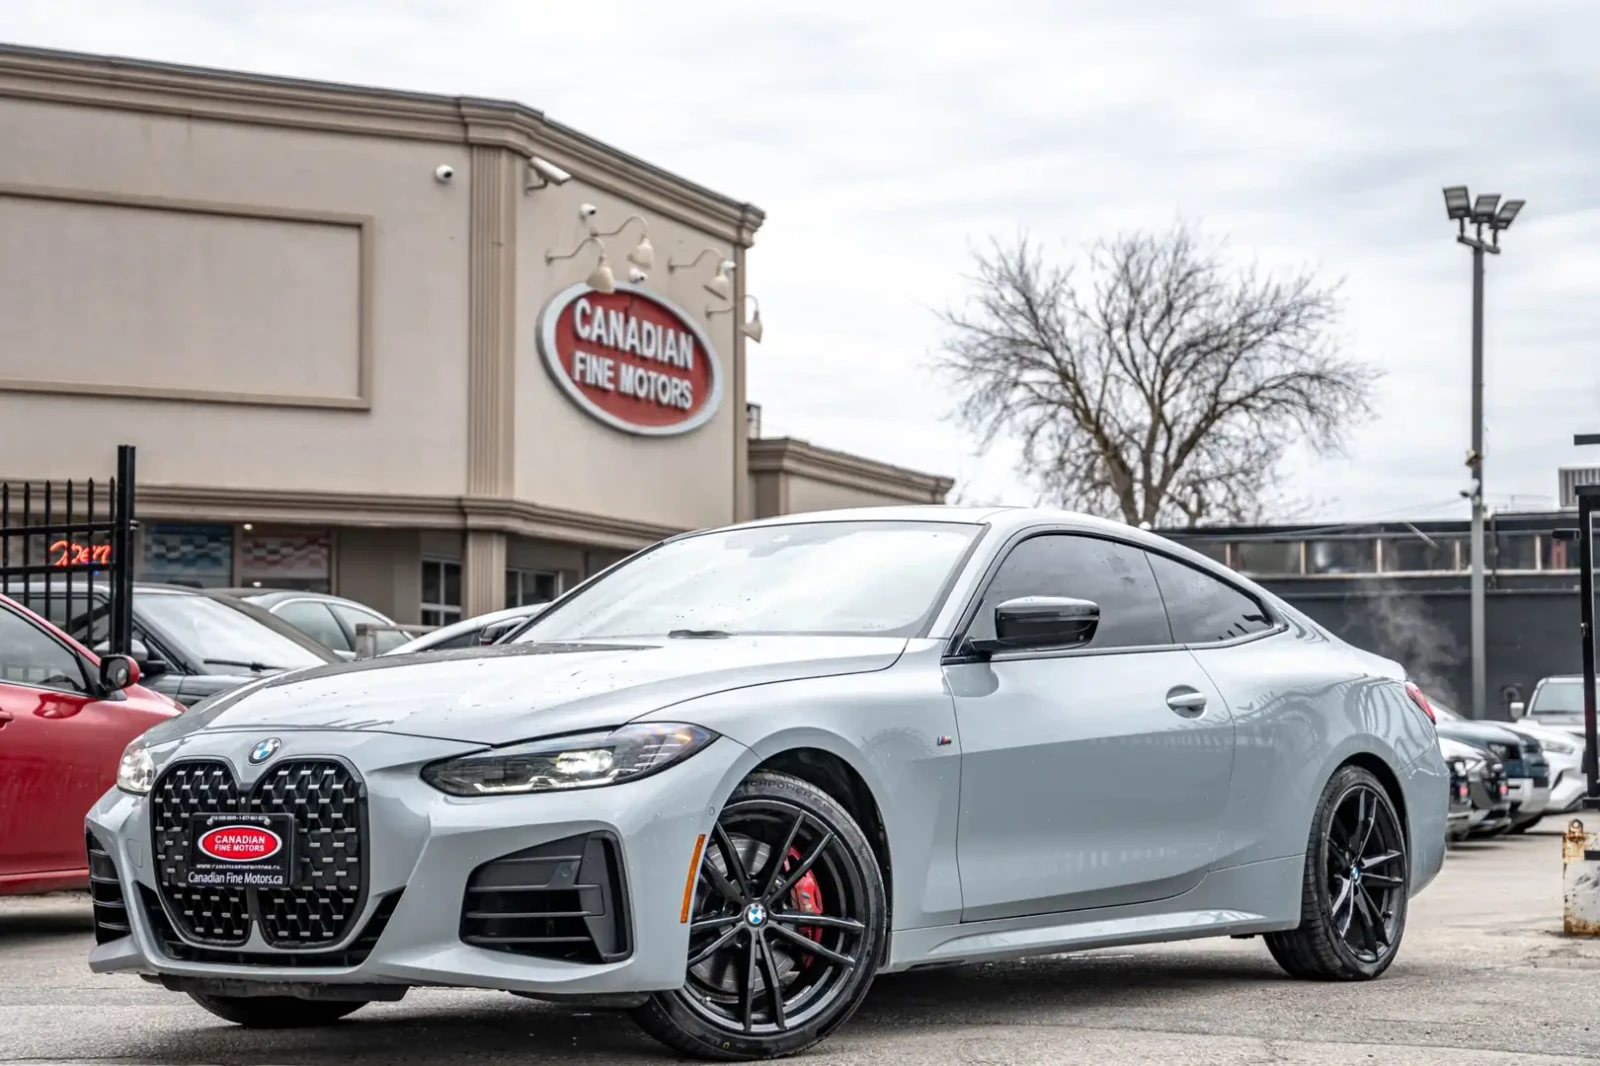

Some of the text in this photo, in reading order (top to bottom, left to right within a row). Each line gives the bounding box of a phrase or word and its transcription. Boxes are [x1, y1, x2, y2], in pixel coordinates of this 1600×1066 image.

[573, 298, 694, 370] CANADIAN
[573, 351, 693, 409] FINE MOTORS
[215, 835, 266, 844] CANADIAN
[214, 844, 265, 852] FINE MOTORS
[188, 871, 283, 885] Canadian Fine Motors.ca
